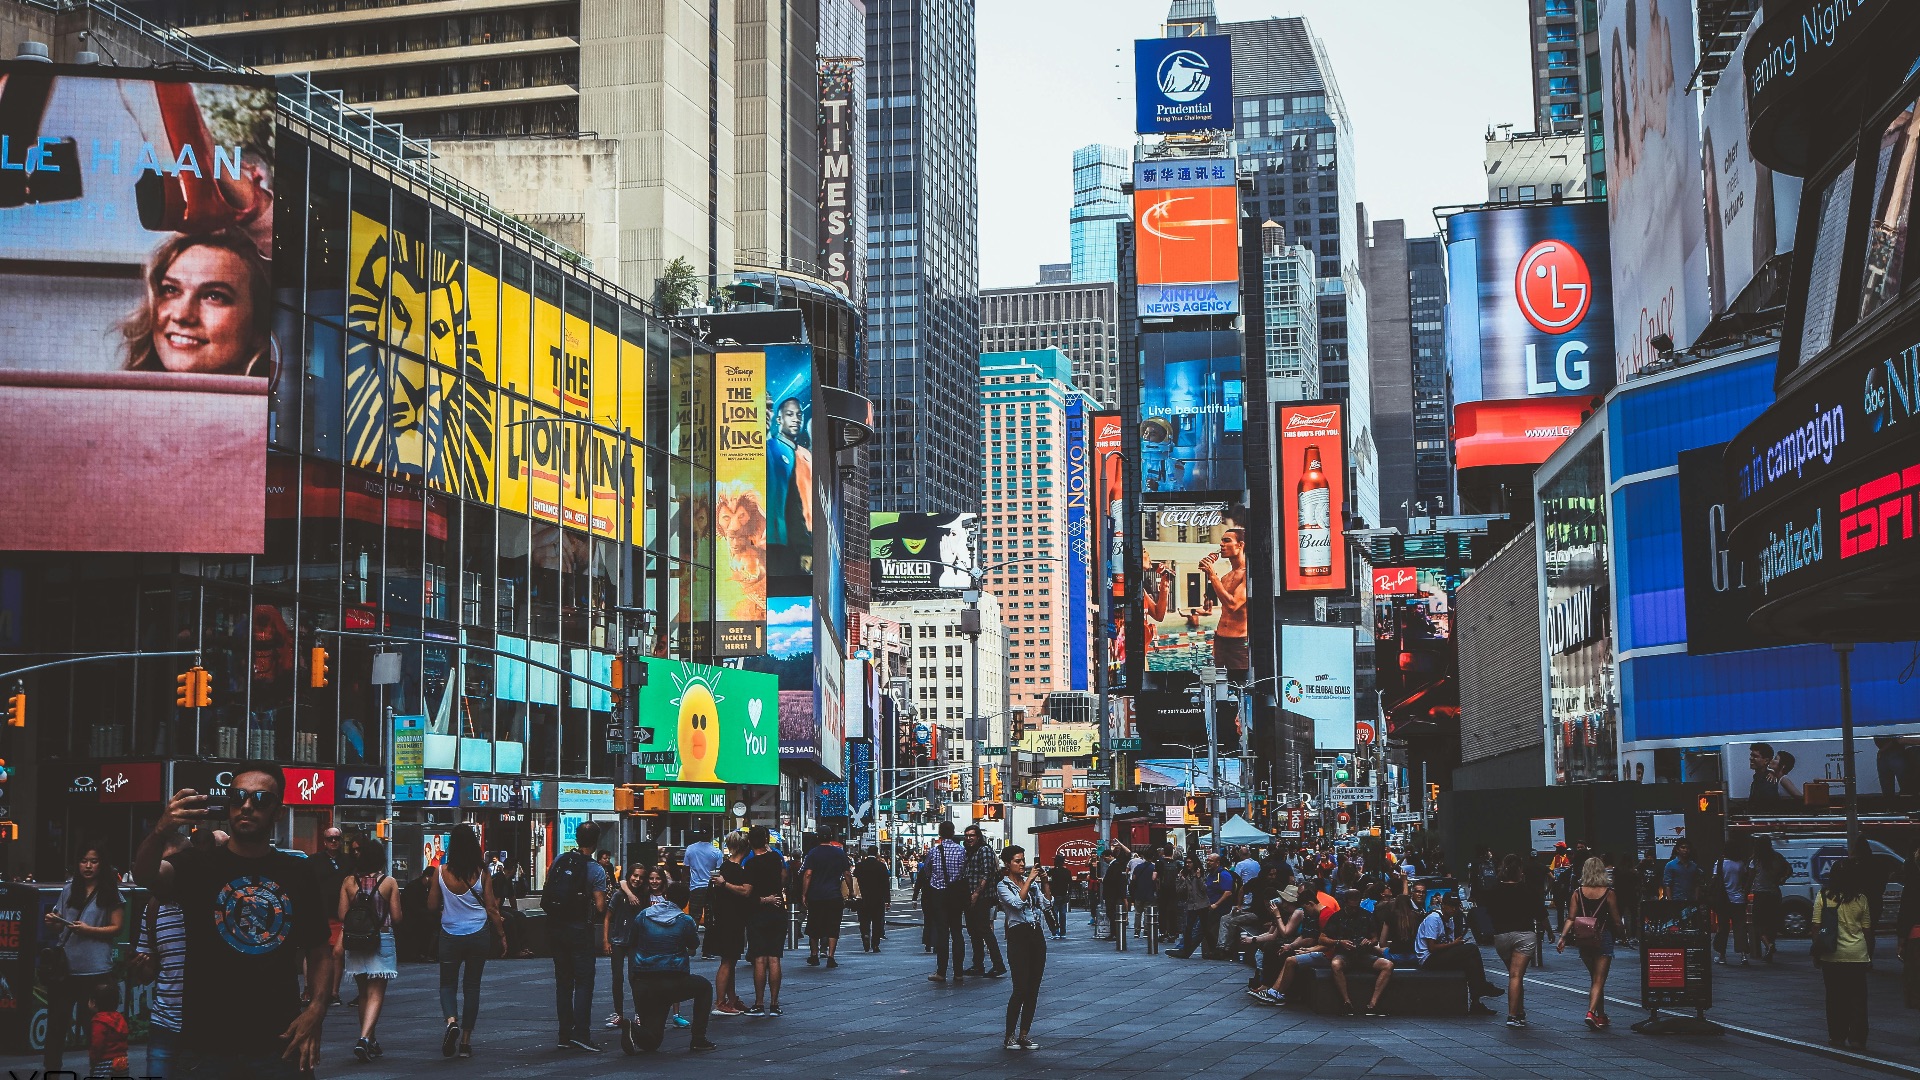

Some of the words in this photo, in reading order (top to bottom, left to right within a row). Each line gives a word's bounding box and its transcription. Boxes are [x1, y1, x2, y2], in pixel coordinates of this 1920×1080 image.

[1802, 0, 1852, 53] Night
[1156, 102, 1213, 116] Prudential
[1, 134, 61, 172] LE
[91, 139, 242, 181] HAAN
[824, 100, 849, 235] TIMES
[1143, 165, 1226, 182] 新华通讯社
[1724, 190, 1744, 230] future
[1159, 288, 1218, 302] XINHUA
[1146, 302, 1180, 314] NEWS
[1182, 300, 1232, 312] AGENCY
[550, 345, 589, 398] THE
[724, 366, 754, 378] Disney
[1525, 340, 1591, 395] LG
[726, 388, 752, 400] THE
[1864, 384, 1886, 415] abc
[722, 402, 758, 424] LION
[1148, 406, 1172, 416] Live
[1175, 403, 1230, 414] beautiful
[1291, 416, 1332, 426] Budweiser
[508, 382, 571, 480] LION
[720, 426, 763, 450] KING
[1753, 446, 1764, 493] in
[1766, 402, 1846, 482] campaign
[1066, 406, 1084, 508] NOVOTEL
[534, 500, 559, 517] ENTRANCE
[564, 508, 574, 521] ON
[574, 511, 588, 526] 45TH
[592, 516, 608, 531] STREET
[1160, 510, 1222, 528] Coca-Cola
[1759, 507, 1824, 596] pitalized
[1375, 570, 1414, 591] Ray-Ban
[1547, 605, 1564, 657] OLD
[1565, 585, 1592, 650] NAVY
[1306, 685, 1315, 694] THE
[1316, 685, 1334, 694] GLOBAL
[1335, 686, 1350, 695] GOALS
[743, 728, 767, 755] YOU
[1112, 740, 1119, 748] W
[1121, 740, 1132, 748] 44
[643, 753, 651, 763] W
[654, 753, 664, 763] 44
[1825, 763, 1842, 779] GA
[209, 787, 227, 796] OAK
[298, 772, 325, 801] Ray-Ban
[672, 792, 687, 806] NEW
[688, 793, 703, 806] YORK
[1166, 808, 1181, 816] HOP
[1292, 810, 1301, 829] tkts
[0, 910, 21, 921] WAY'S
[0, 922, 20, 934] RE
[0, 936, 19, 948] NG
